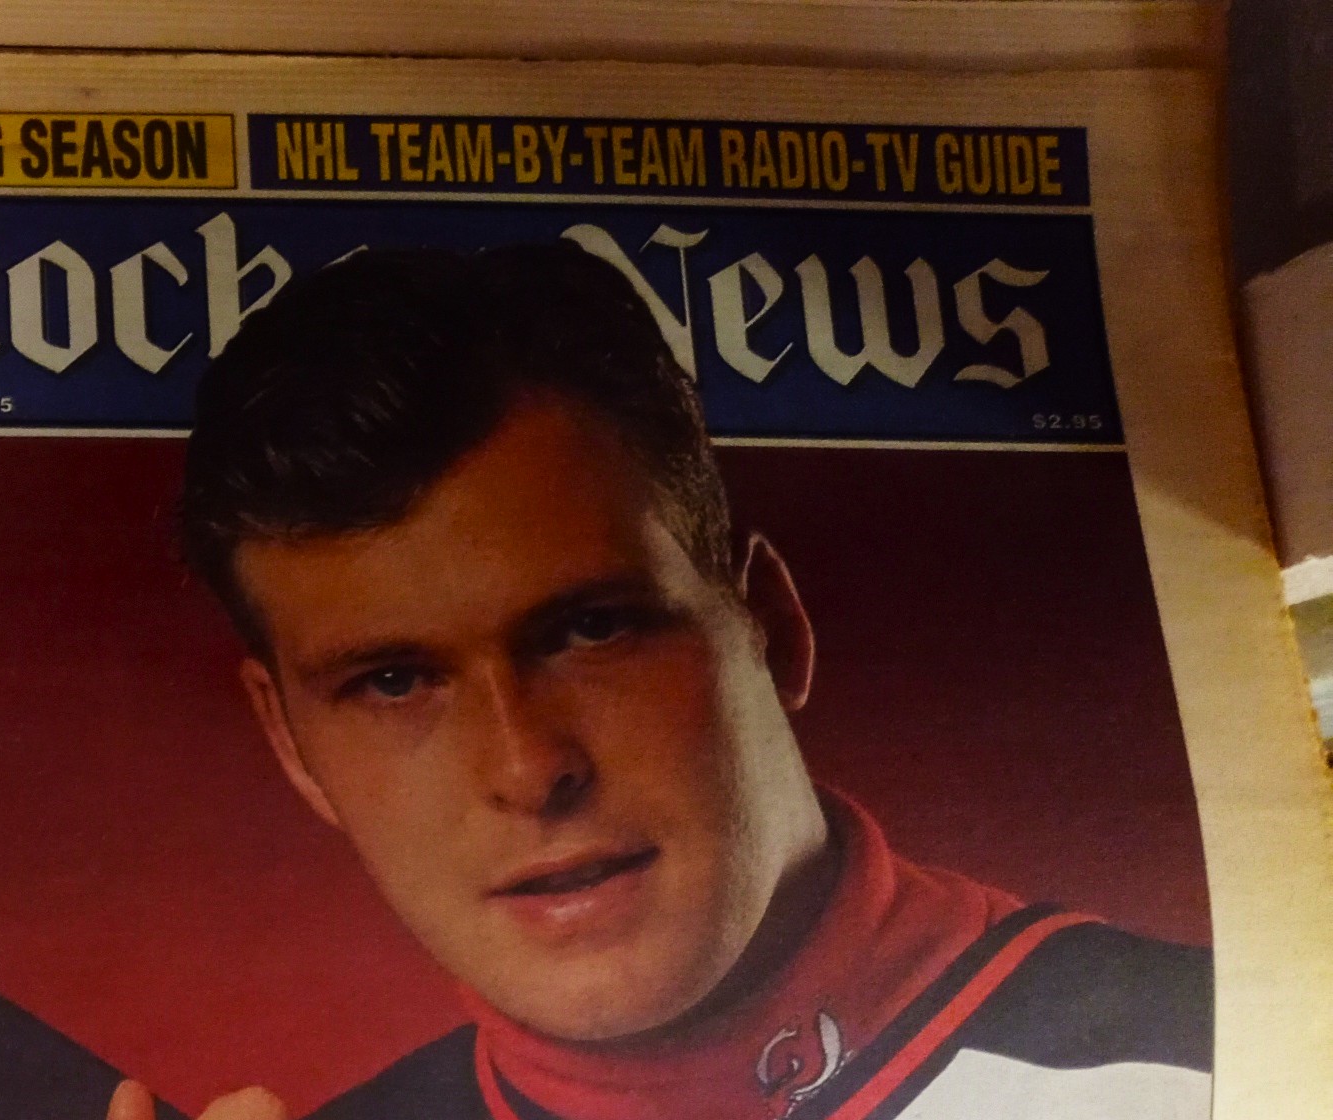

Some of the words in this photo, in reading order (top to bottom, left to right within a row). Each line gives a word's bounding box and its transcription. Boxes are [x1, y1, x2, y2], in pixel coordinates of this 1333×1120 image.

[19, 118, 209, 180] SEASON
[274, 120, 359, 183] NHL
[370, 121, 707, 189] TEAM-BY-TEAM
[721, 127, 920, 195] RADIO-TV
[935, 132, 1064, 197] GUIDE
[560, 222, 1051, 390] News
[1032, 413, 1103, 430] $2.95
